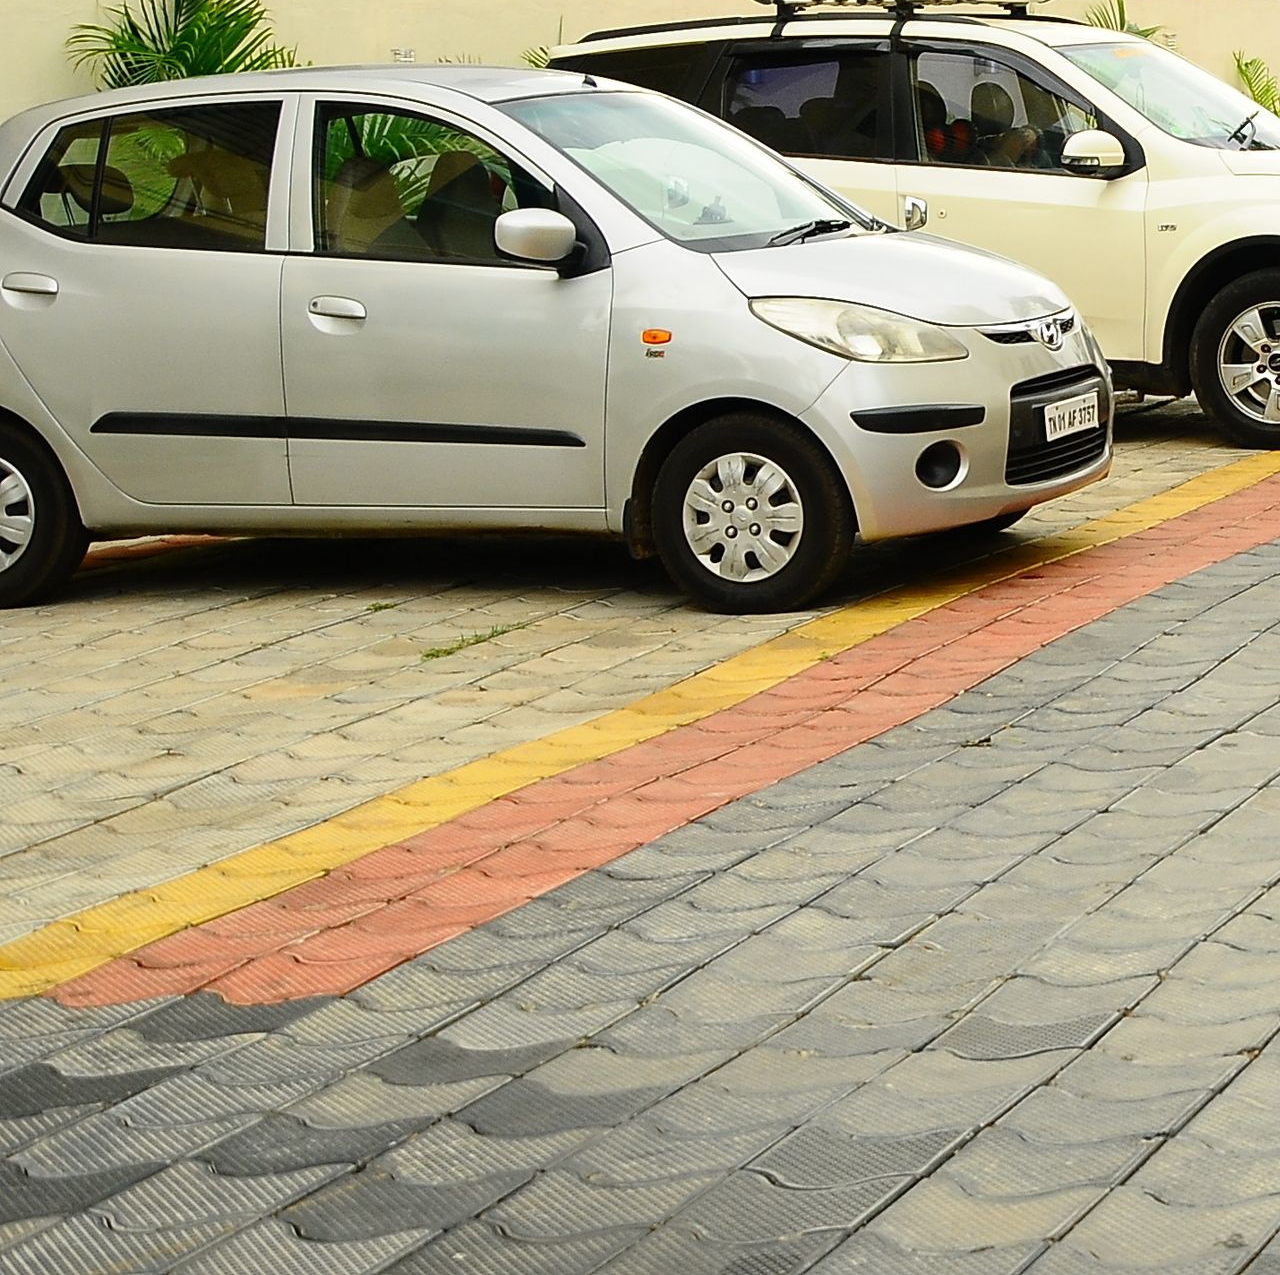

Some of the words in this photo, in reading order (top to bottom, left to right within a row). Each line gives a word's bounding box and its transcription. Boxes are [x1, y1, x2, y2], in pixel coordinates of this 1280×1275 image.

[1048, 415, 1057, 435] TN
[1058, 412, 1066, 432] 01
[1068, 409, 1076, 428] AF
[1078, 404, 1095, 425] 3757
